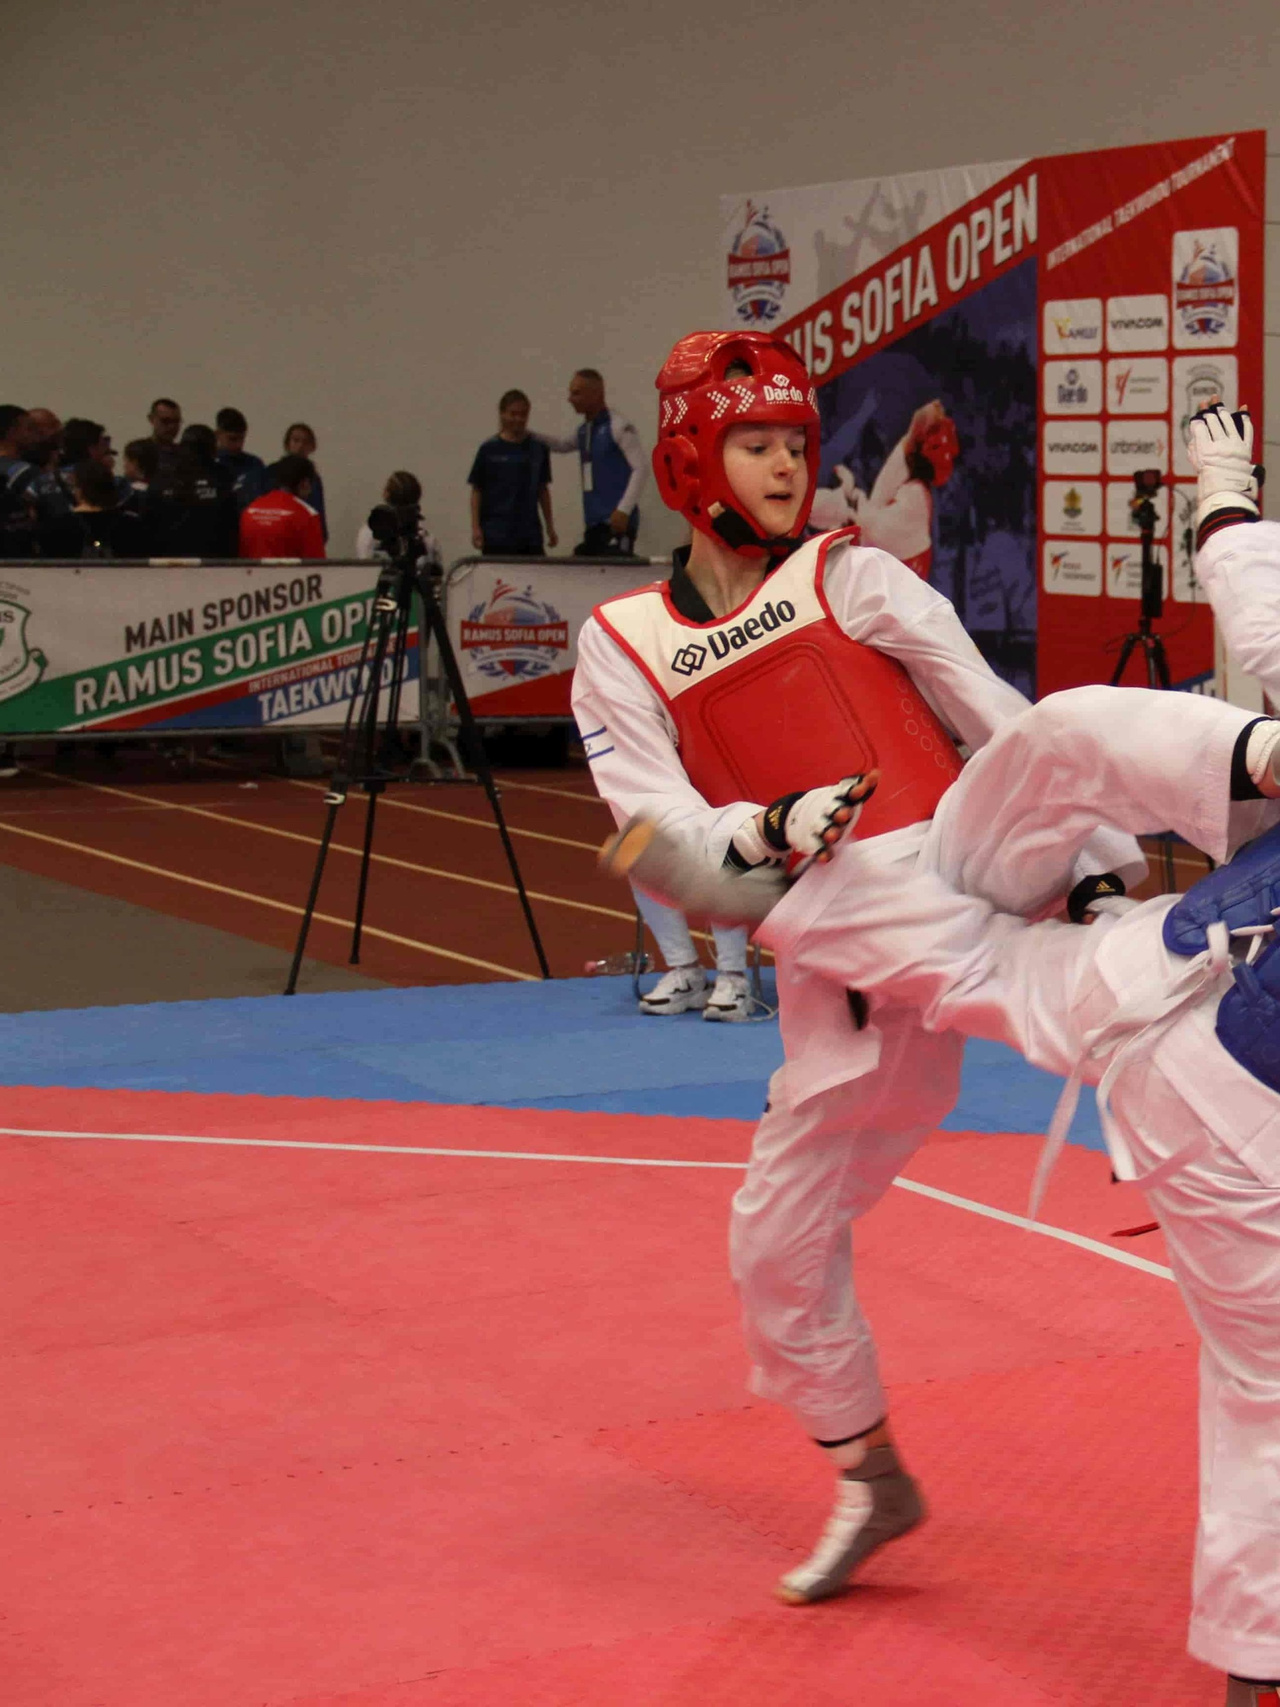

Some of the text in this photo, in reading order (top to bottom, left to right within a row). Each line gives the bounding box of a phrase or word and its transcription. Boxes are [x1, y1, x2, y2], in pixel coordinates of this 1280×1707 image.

[841, 246, 938, 357] SOFIA
[947, 174, 1038, 292] OPEN
[1110, 318, 1163, 330] VIVACOM
[763, 385, 803, 402] Daedo
[1048, 442, 1098, 454] VIVACOM
[125, 574, 322, 652] MAIN SPONSOR
[707, 598, 796, 661] Daedo
[463, 629, 566, 642] RAMUS SOFIA OPEN
[73, 646, 204, 715] RAMUS
[213, 617, 314, 677] SOFIA
[249, 653, 335, 692] INTERNATIONAL
